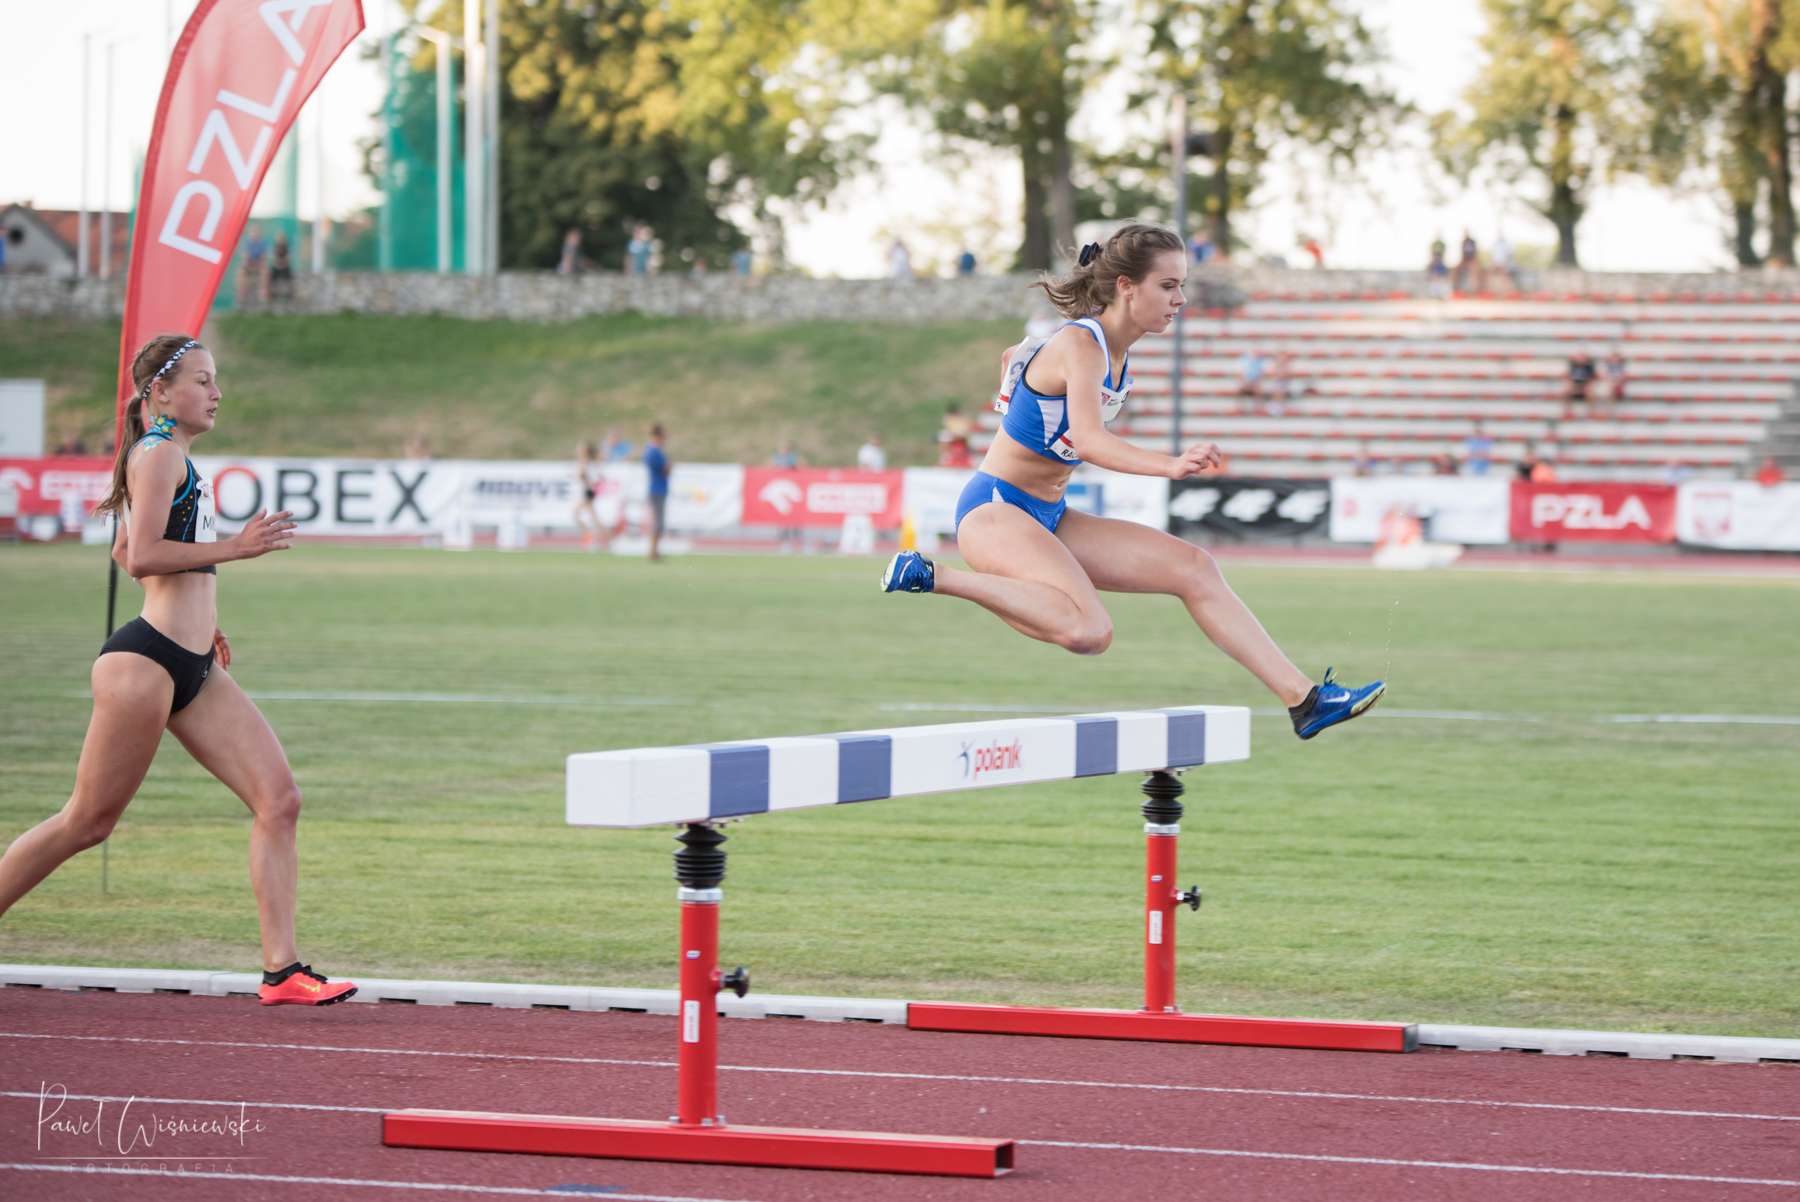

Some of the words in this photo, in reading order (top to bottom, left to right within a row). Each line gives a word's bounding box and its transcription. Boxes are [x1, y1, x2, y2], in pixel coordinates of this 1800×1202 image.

[158, 0, 334, 265] PZLA
[1531, 494, 1652, 530] PZLA
[972, 736, 1023, 781] polanik
